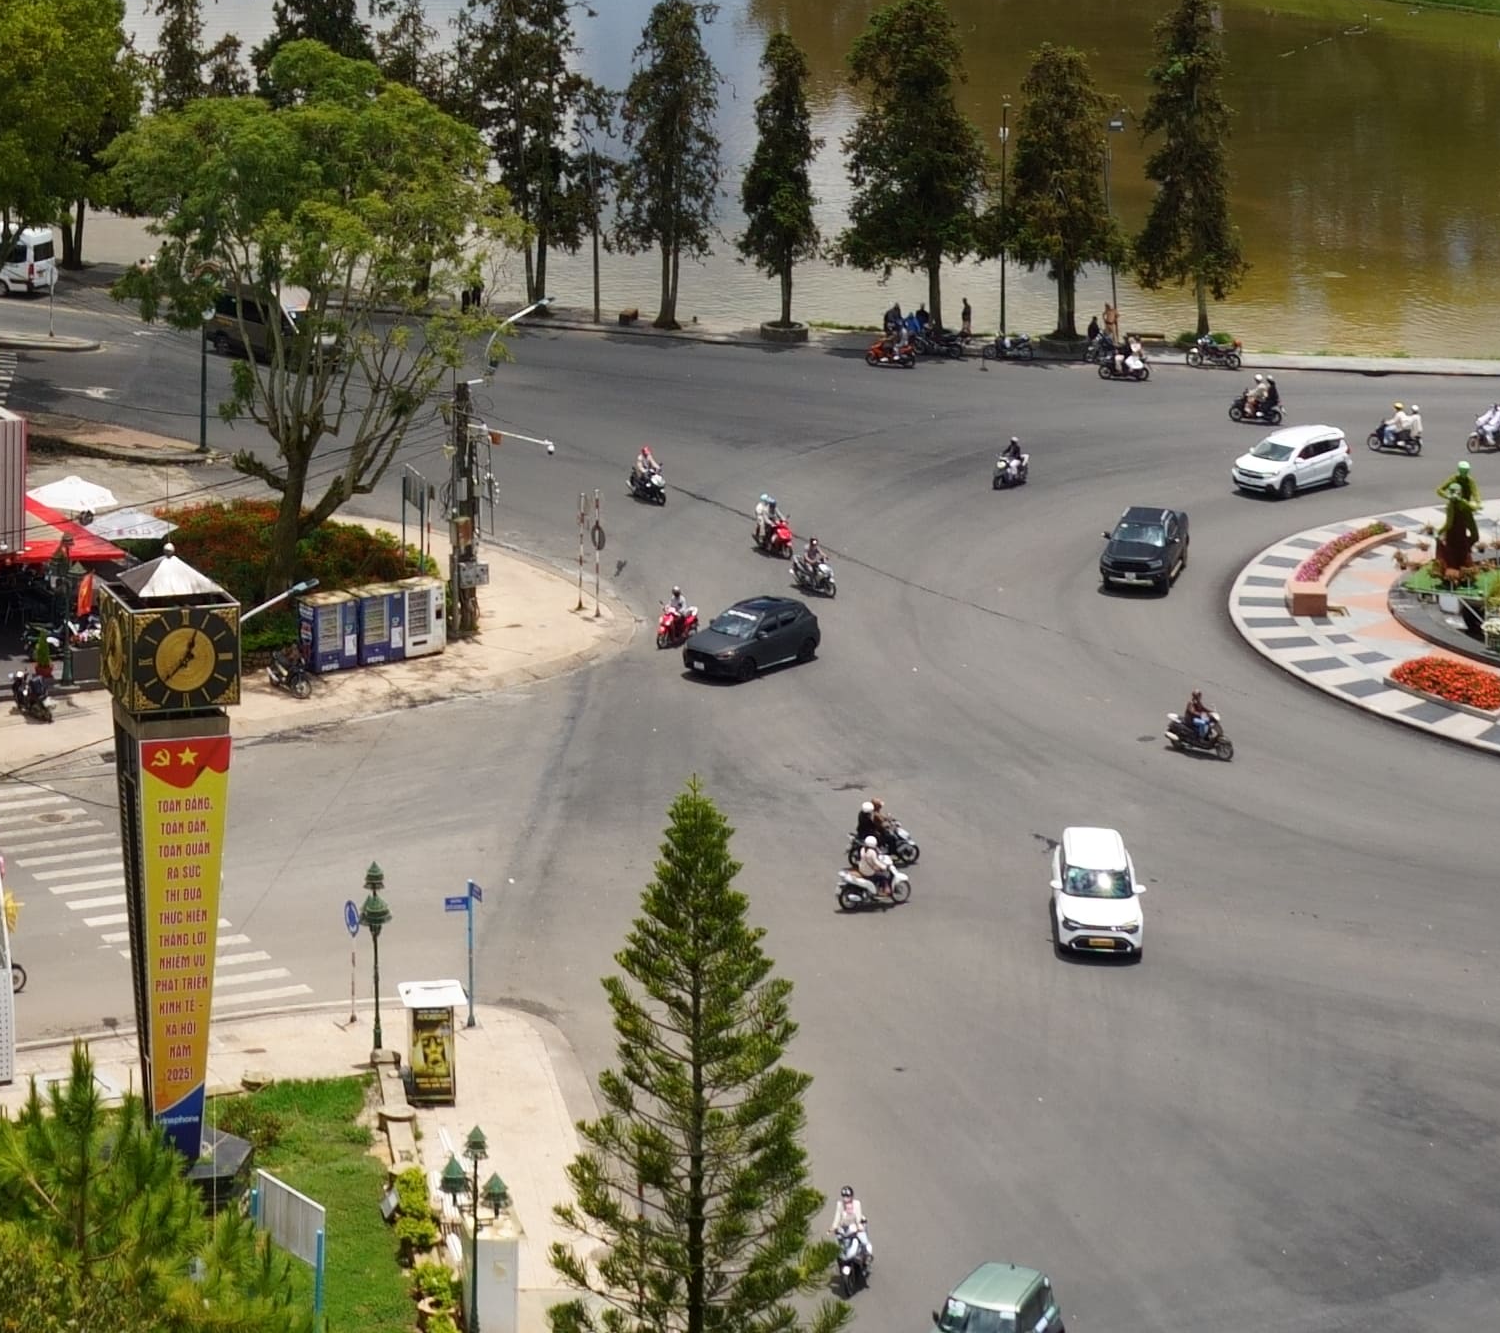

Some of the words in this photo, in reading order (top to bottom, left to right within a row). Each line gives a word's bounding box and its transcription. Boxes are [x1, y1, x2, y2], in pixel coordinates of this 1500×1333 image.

[167, 866, 179, 880] RA
[165, 889, 179, 902] THI
[160, 1000, 181, 1015] KINH
[167, 1066, 193, 1082] 2025!
